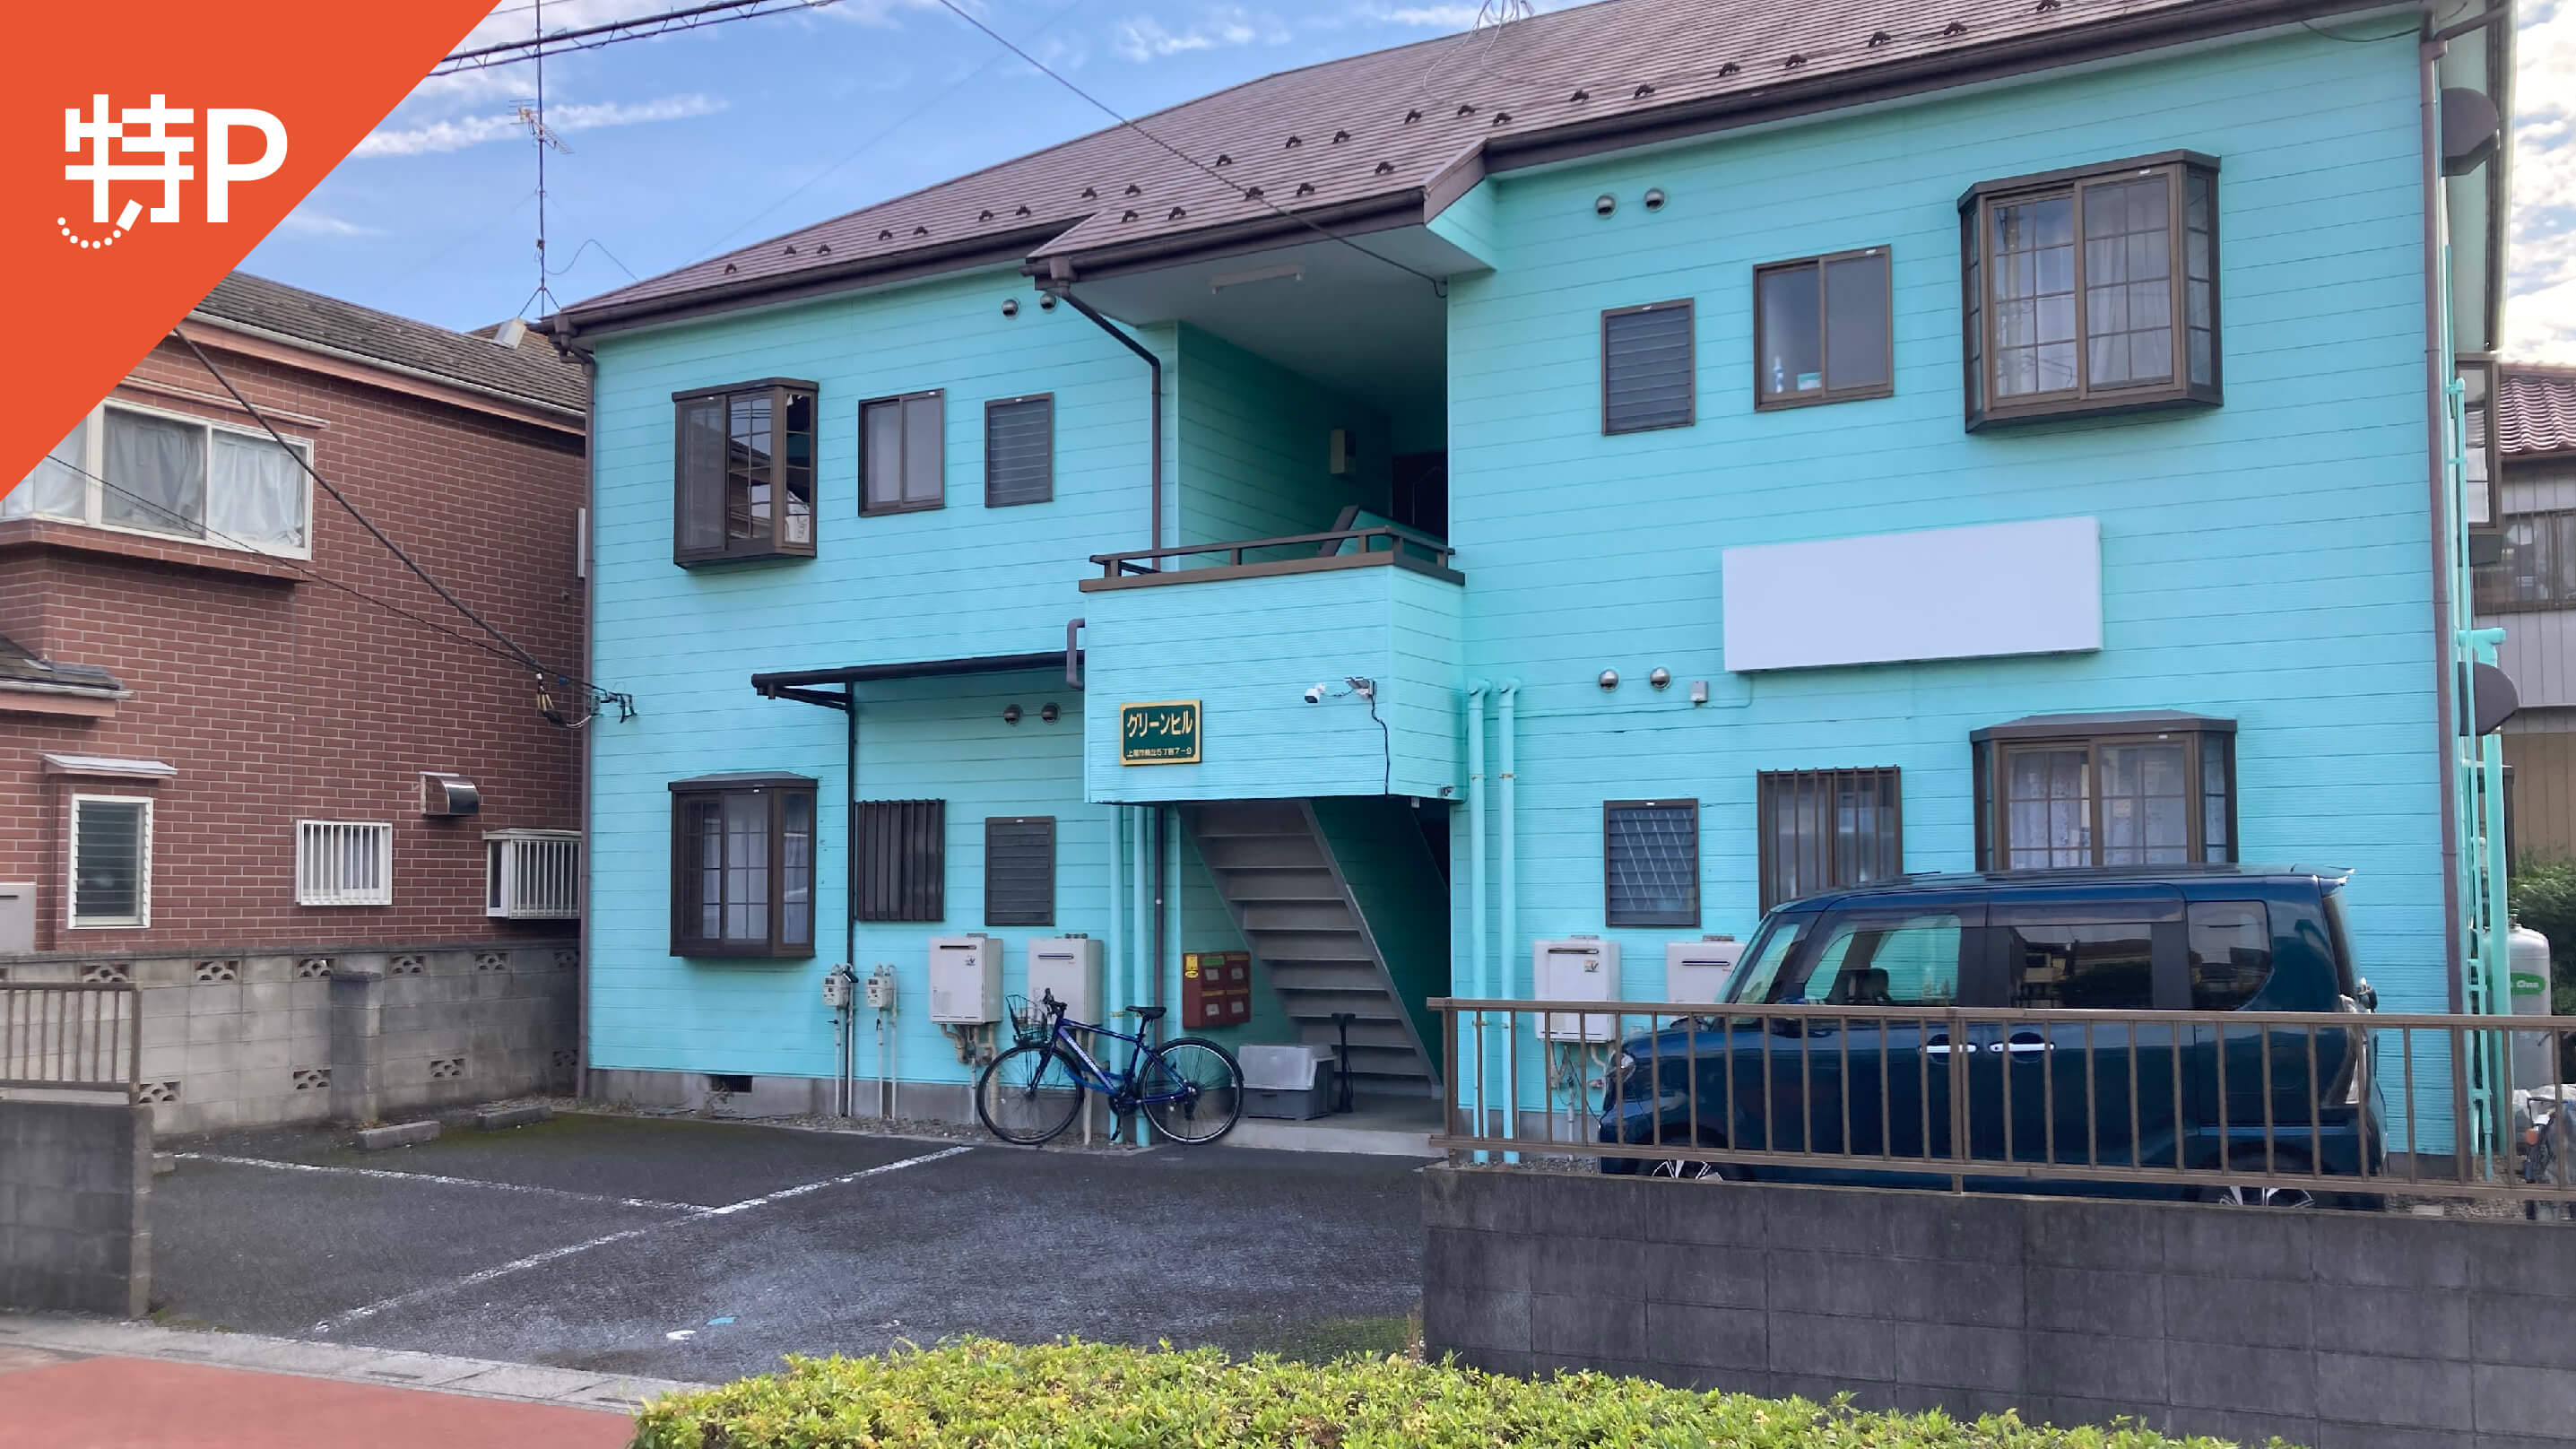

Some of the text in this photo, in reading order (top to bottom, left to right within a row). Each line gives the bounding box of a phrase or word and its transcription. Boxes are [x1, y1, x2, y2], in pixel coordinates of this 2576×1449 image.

[1127, 710, 1193, 737] グリーンヒル
